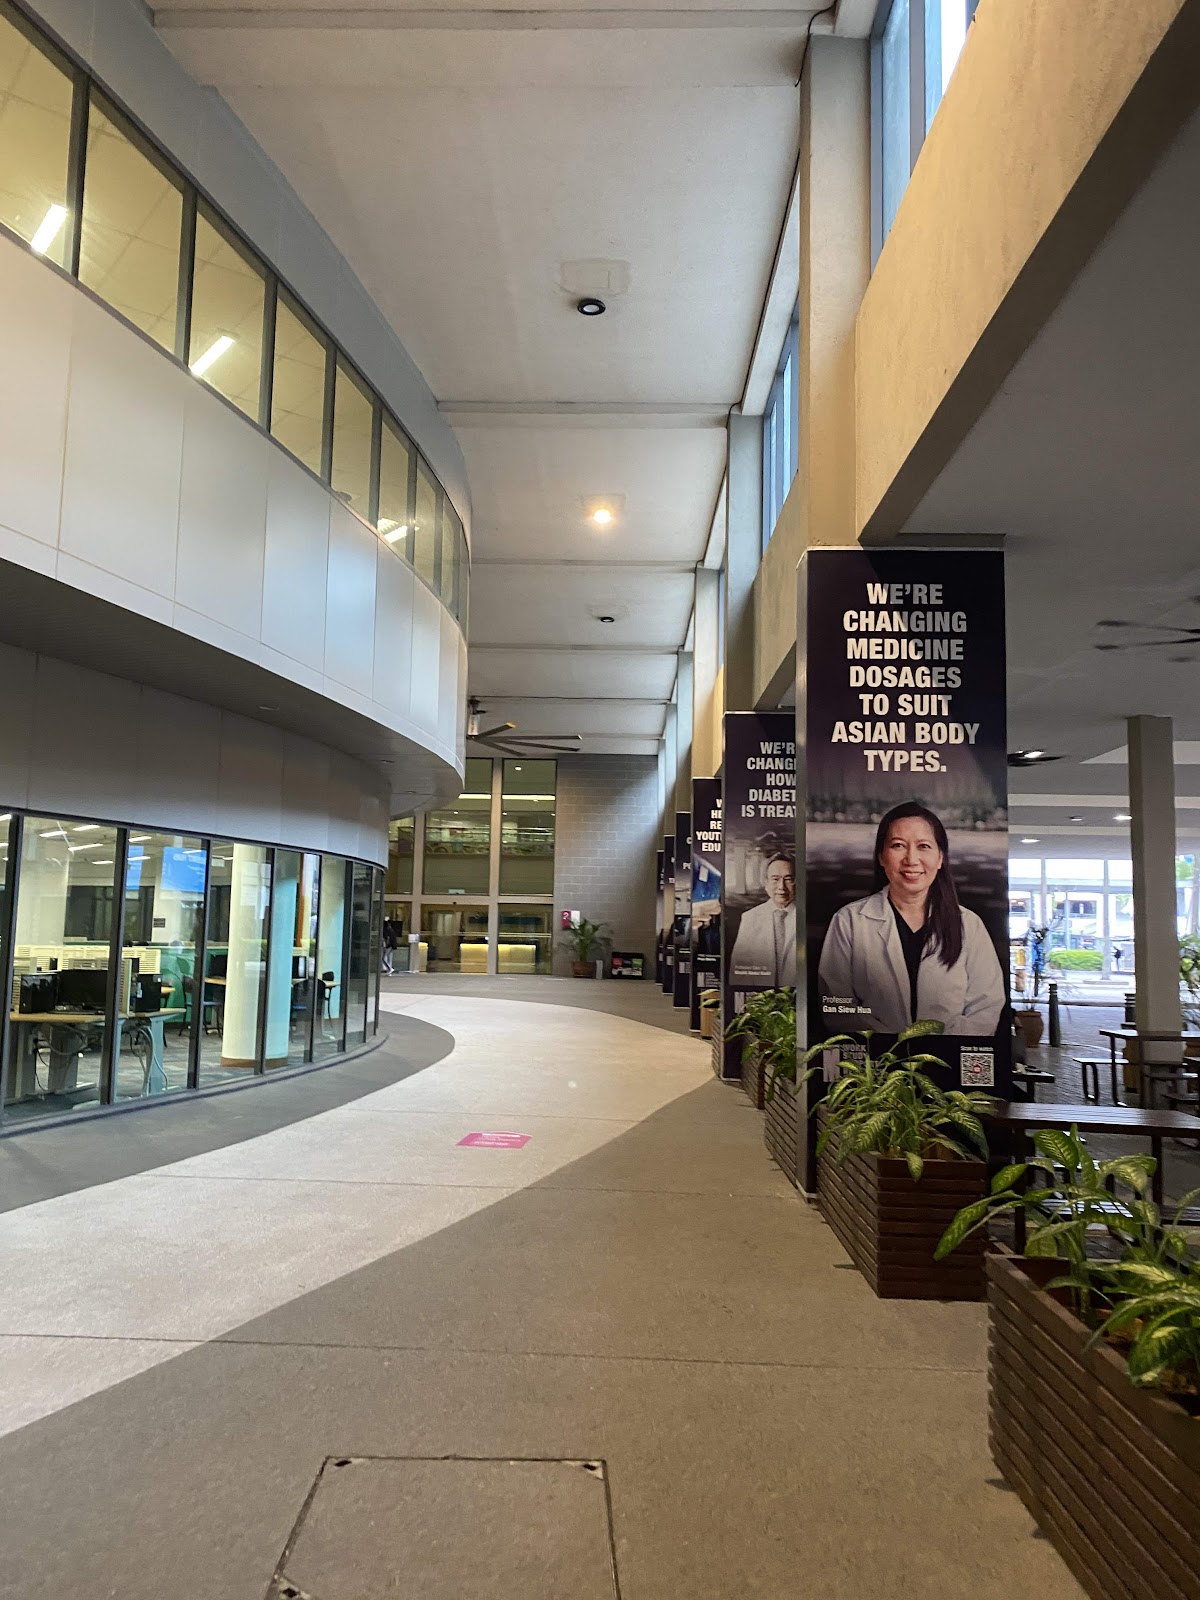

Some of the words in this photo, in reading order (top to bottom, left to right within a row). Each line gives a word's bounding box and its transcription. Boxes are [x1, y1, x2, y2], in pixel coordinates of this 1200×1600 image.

[867, 583, 943, 604] WE'RE
[843, 610, 967, 632] CHANGING
[847, 638, 964, 660] MEDICINE
[850, 665, 962, 688] DOSAGES
[859, 693, 890, 715] TO
[898, 694, 952, 716] SUIT
[831, 721, 906, 744] ASIAN
[915, 722, 980, 745] BODY
[864, 750, 947, 772] TYPES.
[766, 773, 797, 786] HOW
[741, 804, 755, 818] IS
[563, 912, 569, 920] 2
[822, 995, 853, 1004] Professor
[822, 1005, 837, 1013] Gan
